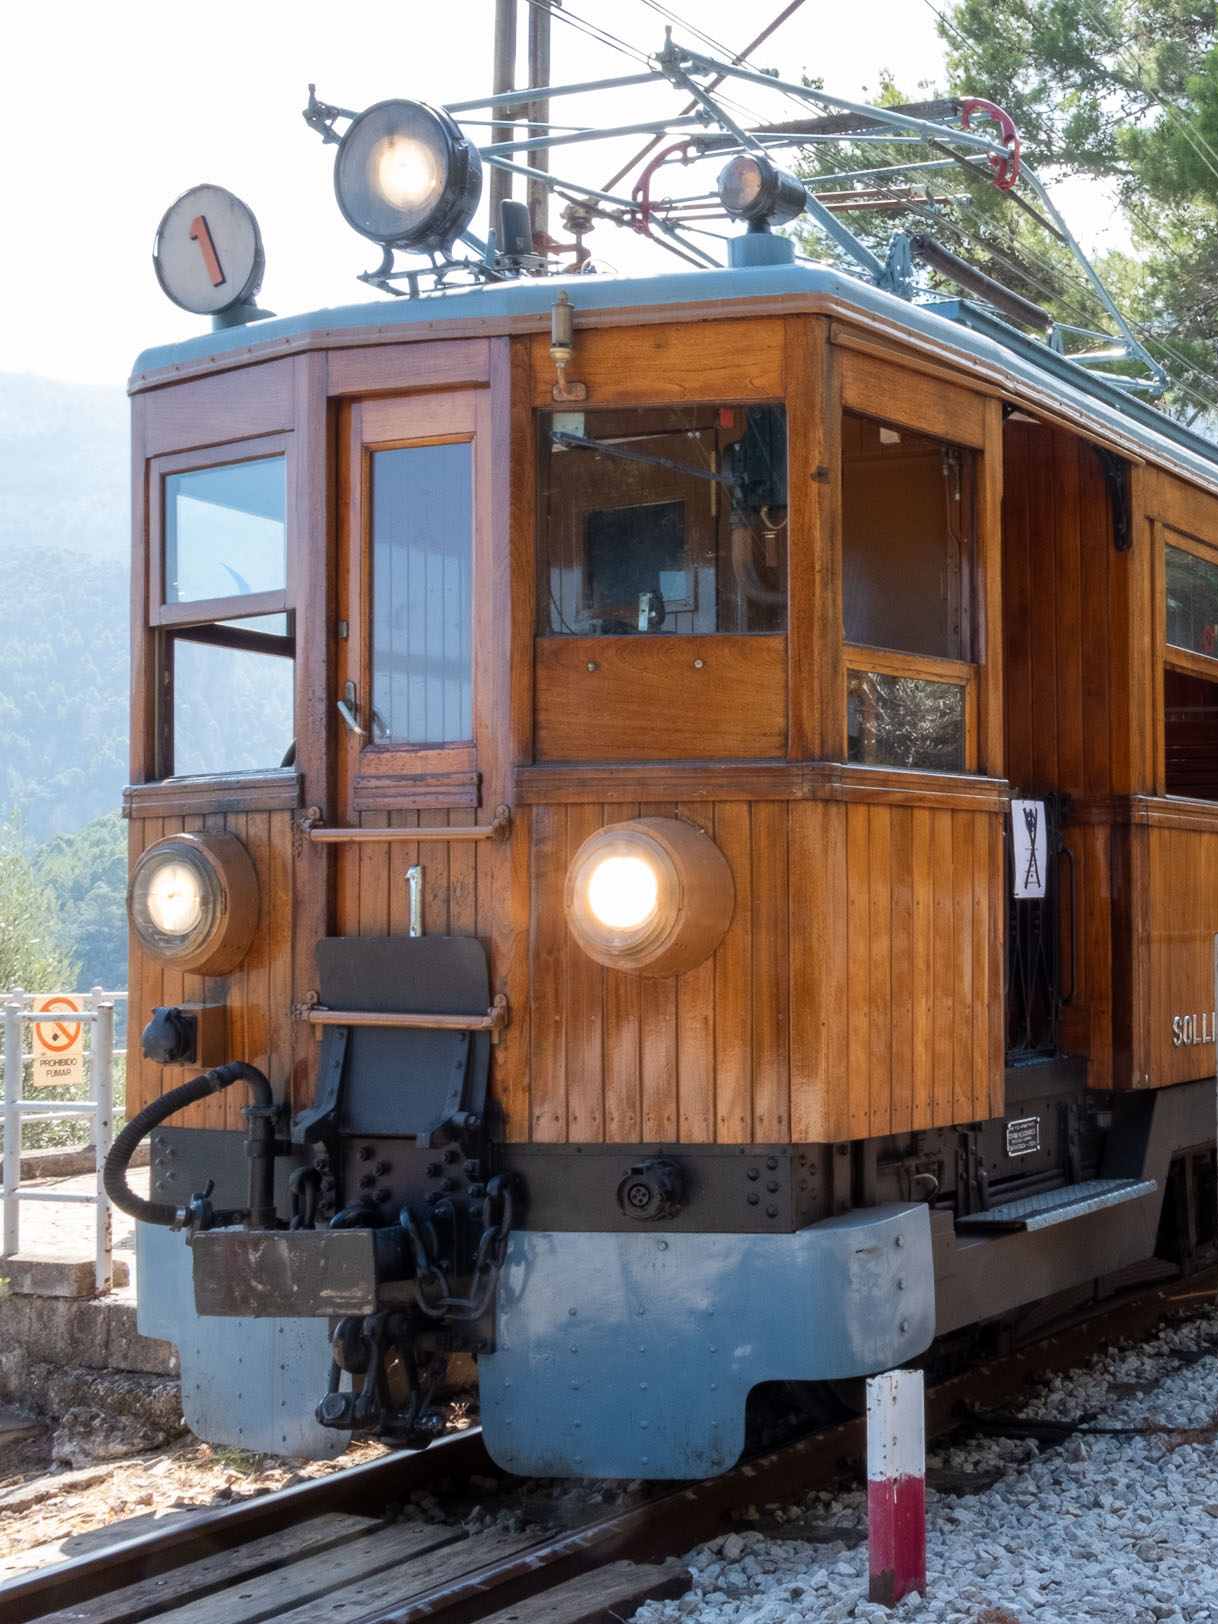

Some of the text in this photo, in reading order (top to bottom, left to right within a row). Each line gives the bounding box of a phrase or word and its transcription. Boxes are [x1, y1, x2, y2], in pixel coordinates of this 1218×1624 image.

[189, 215, 226, 288] 1
[1172, 1011, 1216, 1047] SOLL
[40, 1058, 77, 1067] PROHIBIDO
[46, 1069, 71, 1077] FUMAR
